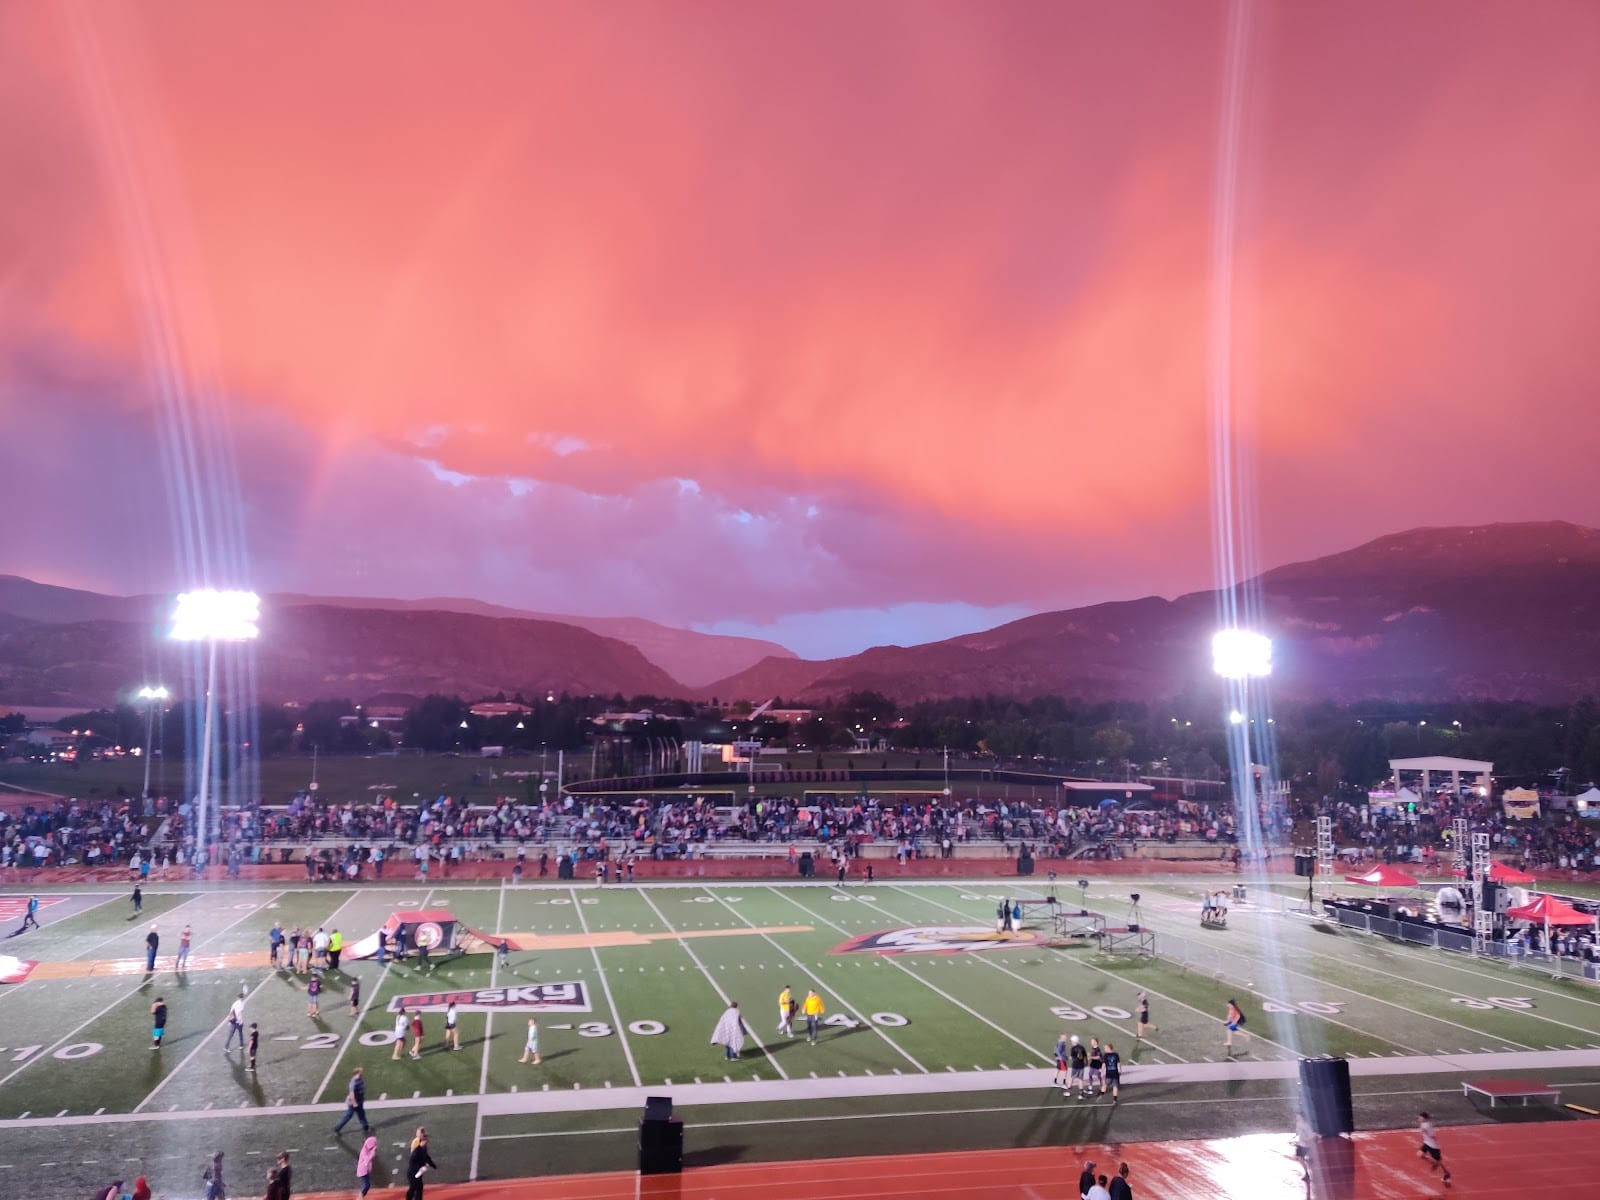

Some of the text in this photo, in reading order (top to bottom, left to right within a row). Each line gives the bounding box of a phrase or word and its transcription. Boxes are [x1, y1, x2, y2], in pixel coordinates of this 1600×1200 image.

[823, 1012, 908, 1028] 40
[1049, 1005, 1133, 1020] 50
[577, 1020, 666, 1038] 30
[299, 1030, 398, 1049] 20
[11, 1042, 104, 1060] 10
